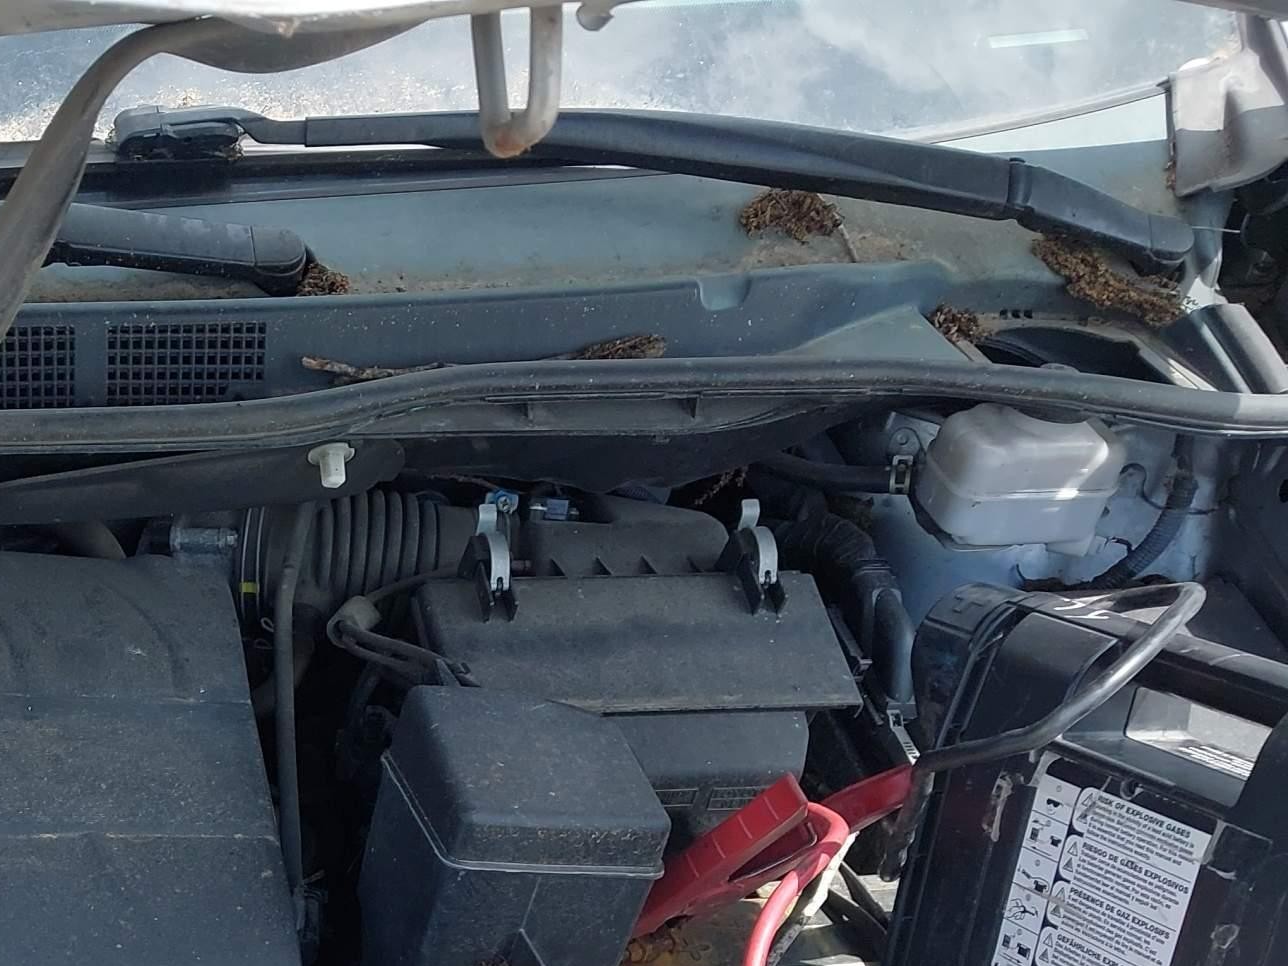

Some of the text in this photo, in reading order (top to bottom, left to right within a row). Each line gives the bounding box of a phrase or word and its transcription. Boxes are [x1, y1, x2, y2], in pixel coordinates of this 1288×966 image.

[1125, 806, 1165, 828] EXPLOSIVE
[1165, 823, 1191, 839] GASES
[1082, 842, 1107, 858] RIESGO
[1107, 852, 1119, 864] DE
[1143, 867, 1189, 895] EXPLOSIVOS
[1105, 903, 1116, 914] DE
